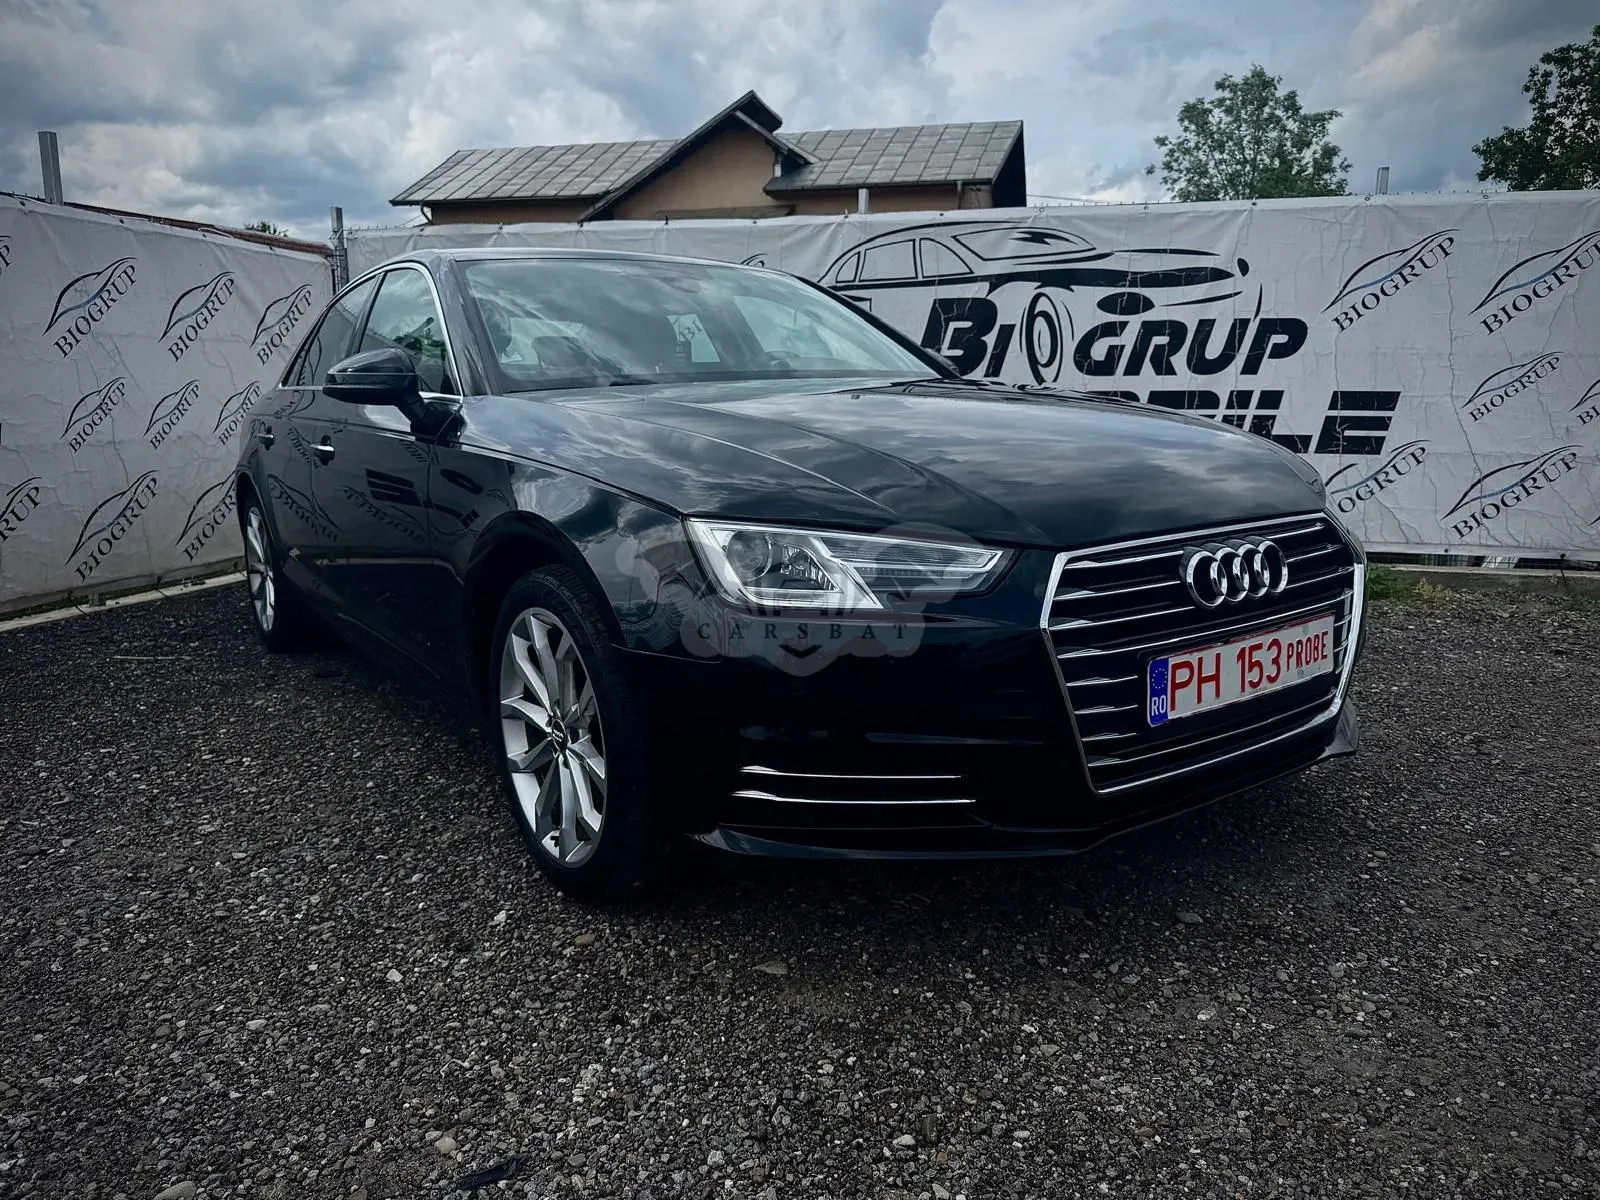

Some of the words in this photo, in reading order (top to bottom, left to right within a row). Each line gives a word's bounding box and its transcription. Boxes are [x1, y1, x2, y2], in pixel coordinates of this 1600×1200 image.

[53, 264, 137, 358] BIOGRUP
[167, 278, 235, 362] BIOGRUP
[1332, 236, 1455, 333] BIOGRUP
[256, 290, 313, 366] BIOGRUP
[69, 382, 126, 453] BIOGRUP
[150, 384, 200, 450] BIOGRUP
[218, 385, 263, 446] BIOGRUP
[1468, 356, 1560, 422] BIOGRUP
[74, 477, 158, 583] BIOGRUP
[183, 488, 237, 562] BIOGR
[1452, 452, 1577, 538] BIOGRUP
[1151, 695, 1167, 716] RO
[1169, 653, 1221, 712] PH
[1236, 638, 1282, 693] 153
[1286, 630, 1329, 672] PROBE
